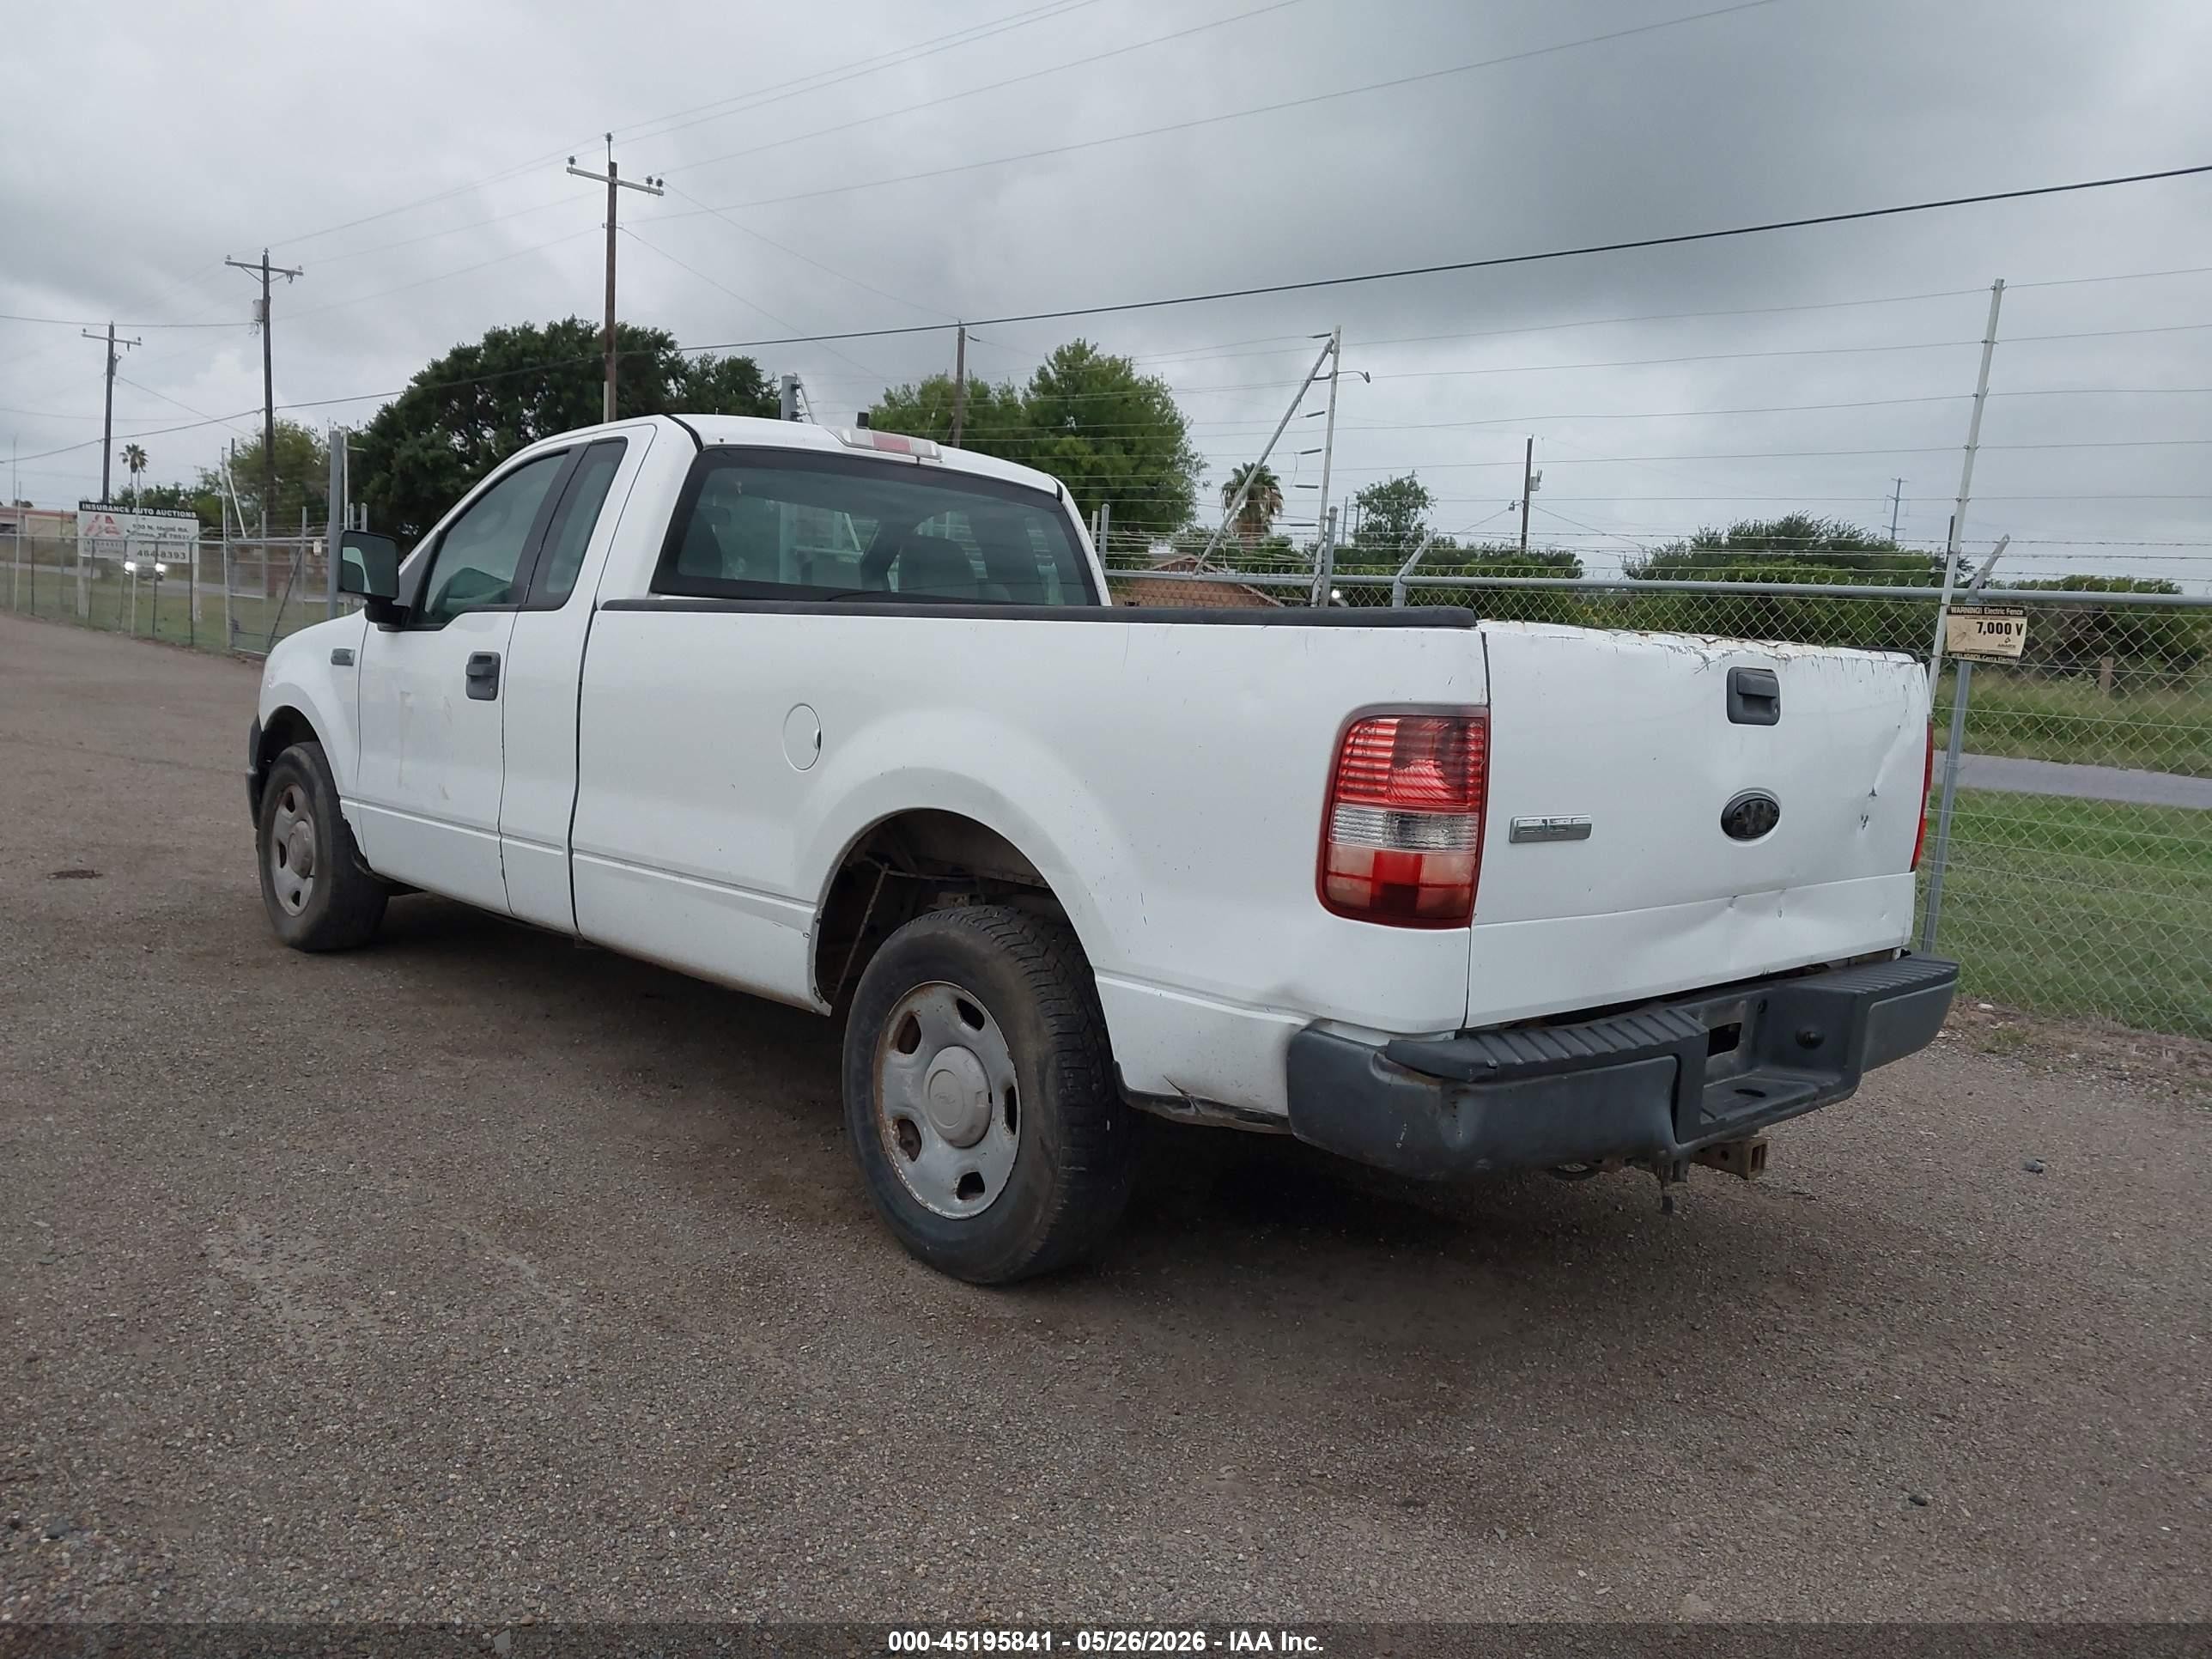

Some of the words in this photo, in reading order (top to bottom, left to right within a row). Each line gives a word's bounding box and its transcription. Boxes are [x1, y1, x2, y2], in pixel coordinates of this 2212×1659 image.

[82, 503, 130, 514] INSURANCE
[132, 507, 154, 515] AUTO
[155, 509, 197, 519] AUCTIONS
[1950, 606, 1983, 615] WARNING!
[1984, 606, 2005, 615] Electric
[1976, 621, 2013, 635] 7,000
[2015, 623, 2024, 636] V
